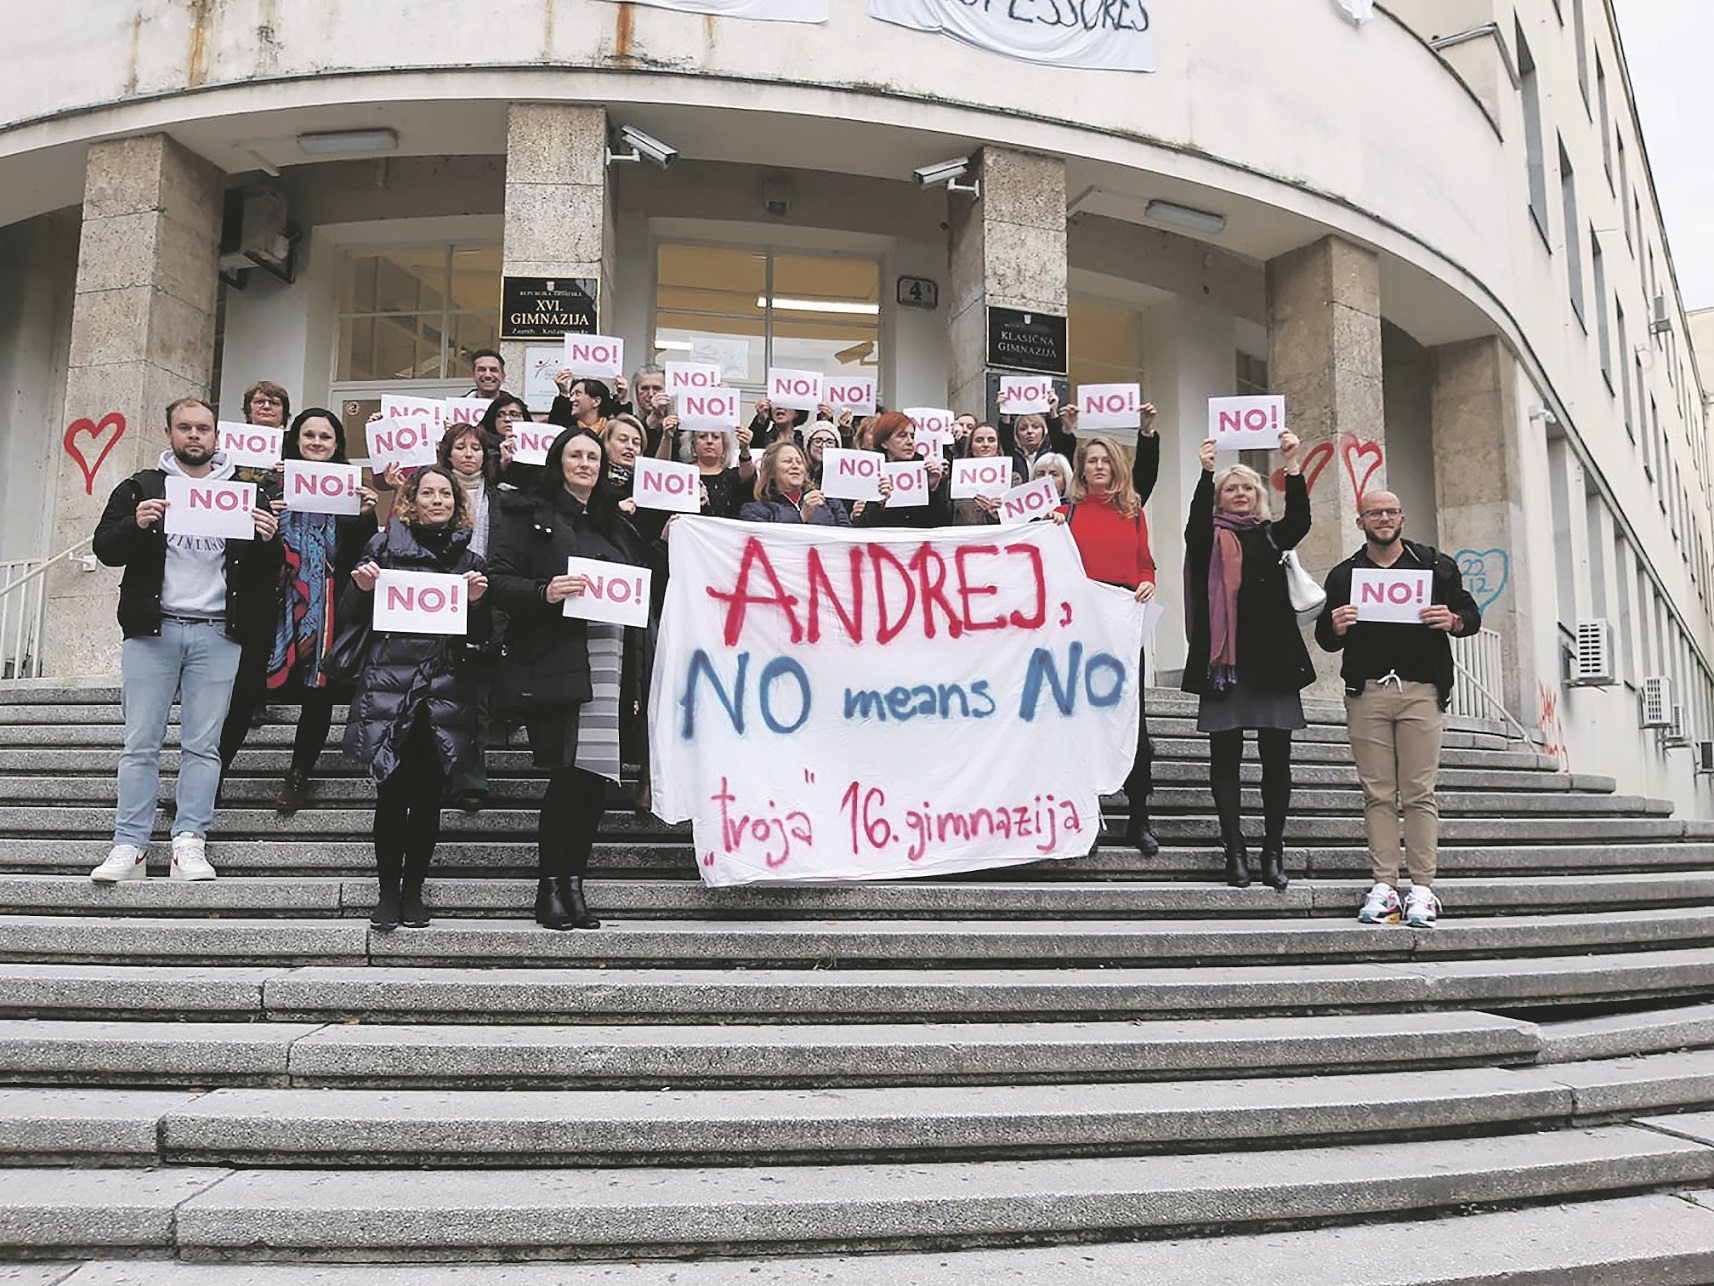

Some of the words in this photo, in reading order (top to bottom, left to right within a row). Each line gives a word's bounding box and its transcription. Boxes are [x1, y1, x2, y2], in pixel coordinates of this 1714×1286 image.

[536, 299, 564, 312] XVI.
[510, 312, 589, 326] GIMNAZIJA
[573, 344, 618, 364] NO!
[997, 341, 1057, 358] GIMNAZIJA
[673, 371, 716, 387] NO!
[776, 378, 818, 396] NO!
[830, 384, 871, 402] NO!
[1007, 383, 1047, 402] NO!
[1086, 391, 1134, 413] NO!
[687, 396, 734, 416] NO!
[1219, 405, 1277, 432] NO!
[225, 433, 276, 454] NO!
[376, 423, 428, 454] NO!
[521, 433, 556, 451] NO
[914, 439, 938, 458] O!
[839, 458, 881, 478] NO!
[960, 465, 1006, 484] NO!
[295, 473, 354, 497] NO!
[643, 471, 694, 496] NO!
[190, 488, 249, 512] NO!
[1005, 484, 1054, 518] NO!
[580, 573, 642, 605] NO!
[706, 536, 1073, 646] ANDREJ,
[1362, 580, 1423, 605] NO!
[387, 586, 459, 613] NO!
[679, 646, 812, 741] NO
[843, 679, 996, 722] means
[1018, 641, 1126, 723] NO
